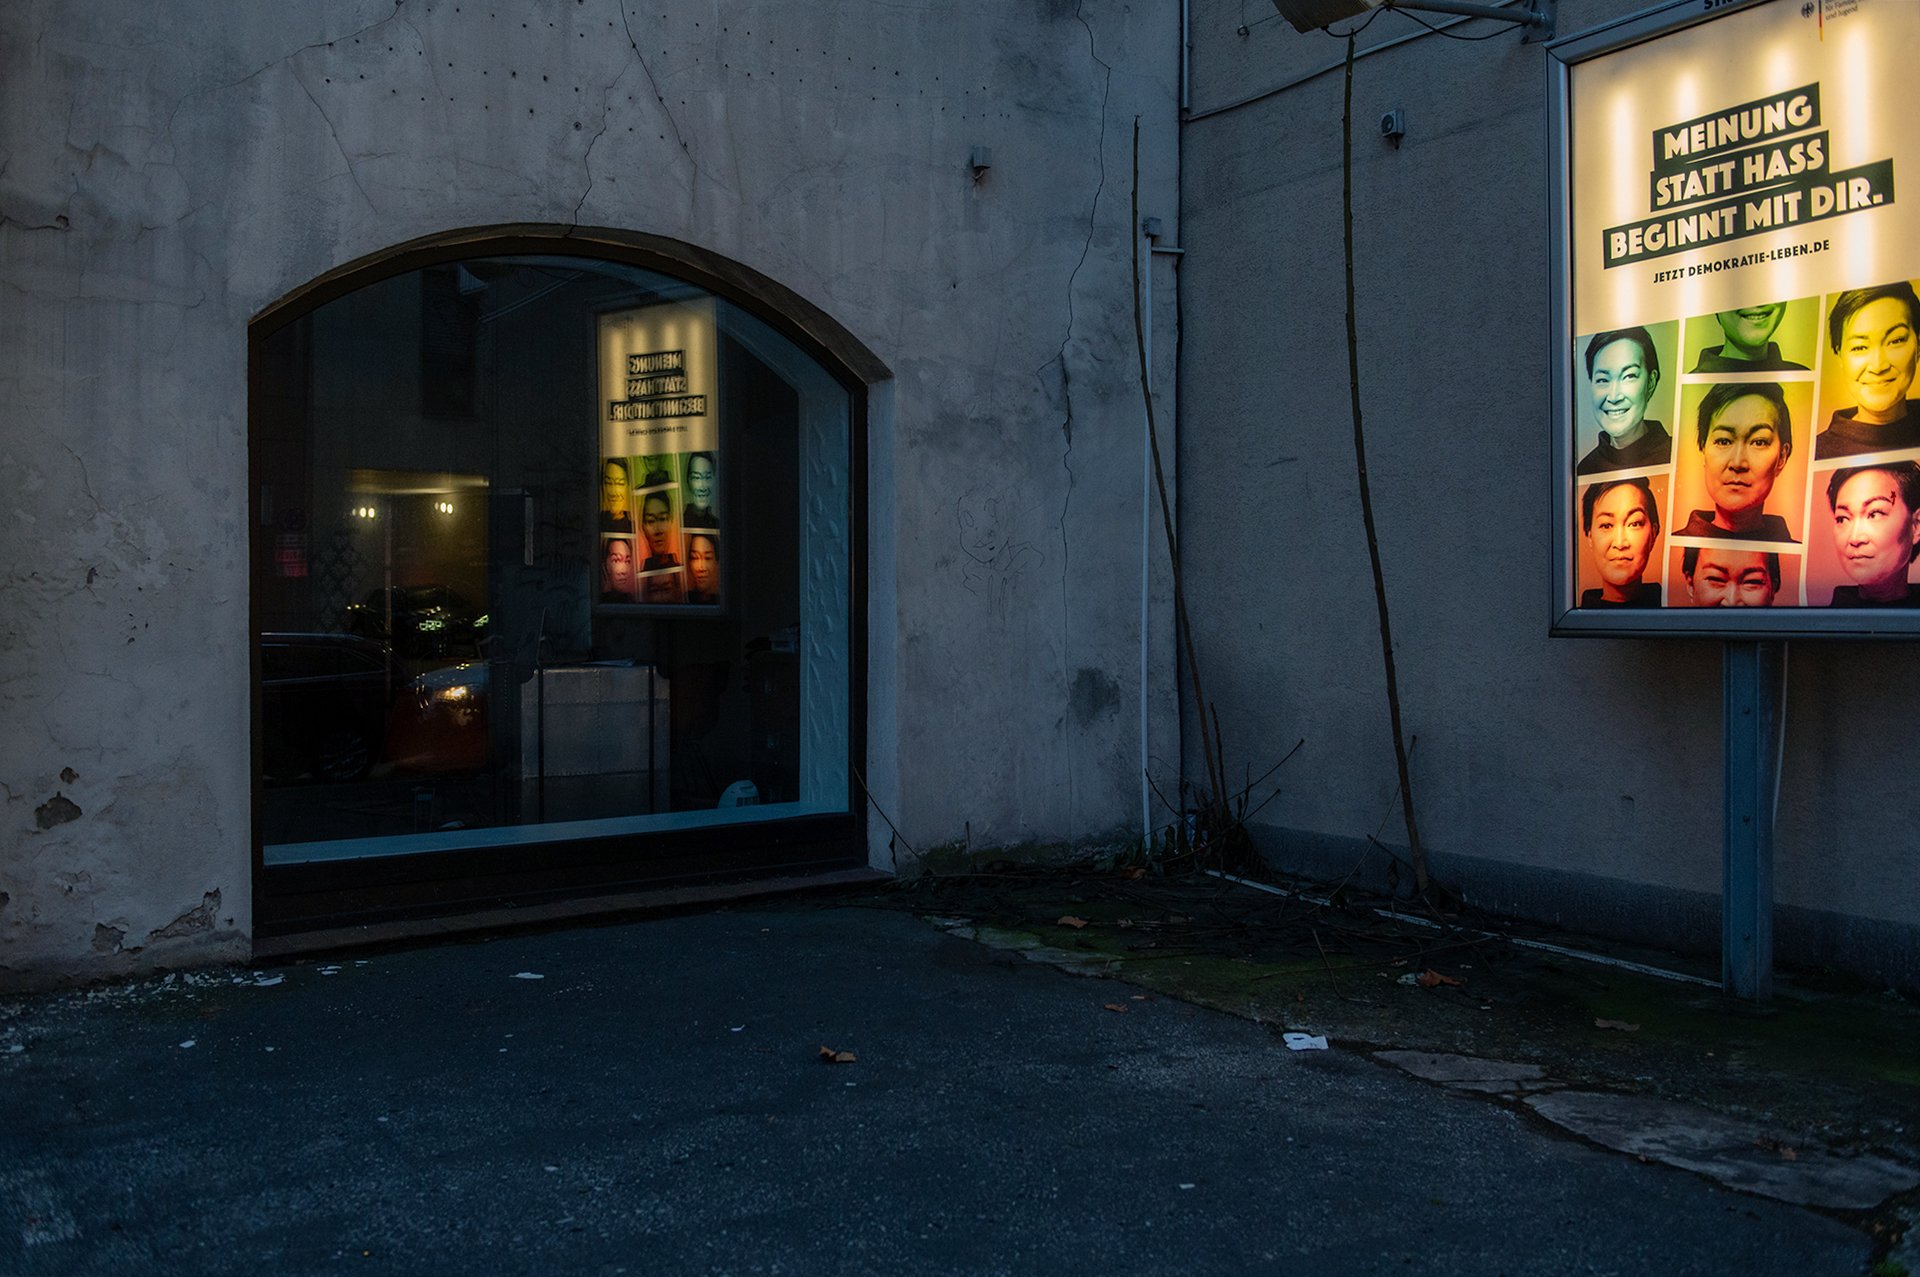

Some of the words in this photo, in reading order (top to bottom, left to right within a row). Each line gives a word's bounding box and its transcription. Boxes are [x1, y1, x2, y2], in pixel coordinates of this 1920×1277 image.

[1664, 94, 1813, 160] MEINUNG
[1656, 160, 1736, 207] STATT
[1743, 138, 1825, 186] HASS
[1610, 206, 1738, 260] BEGINNT
[1745, 191, 1802, 231] MIT
[1811, 177, 1883, 217] DIR.
[1653, 267, 1685, 284] JETZT
[1688, 239, 1831, 277] DEMOKRATIE-LEBEN.DE
